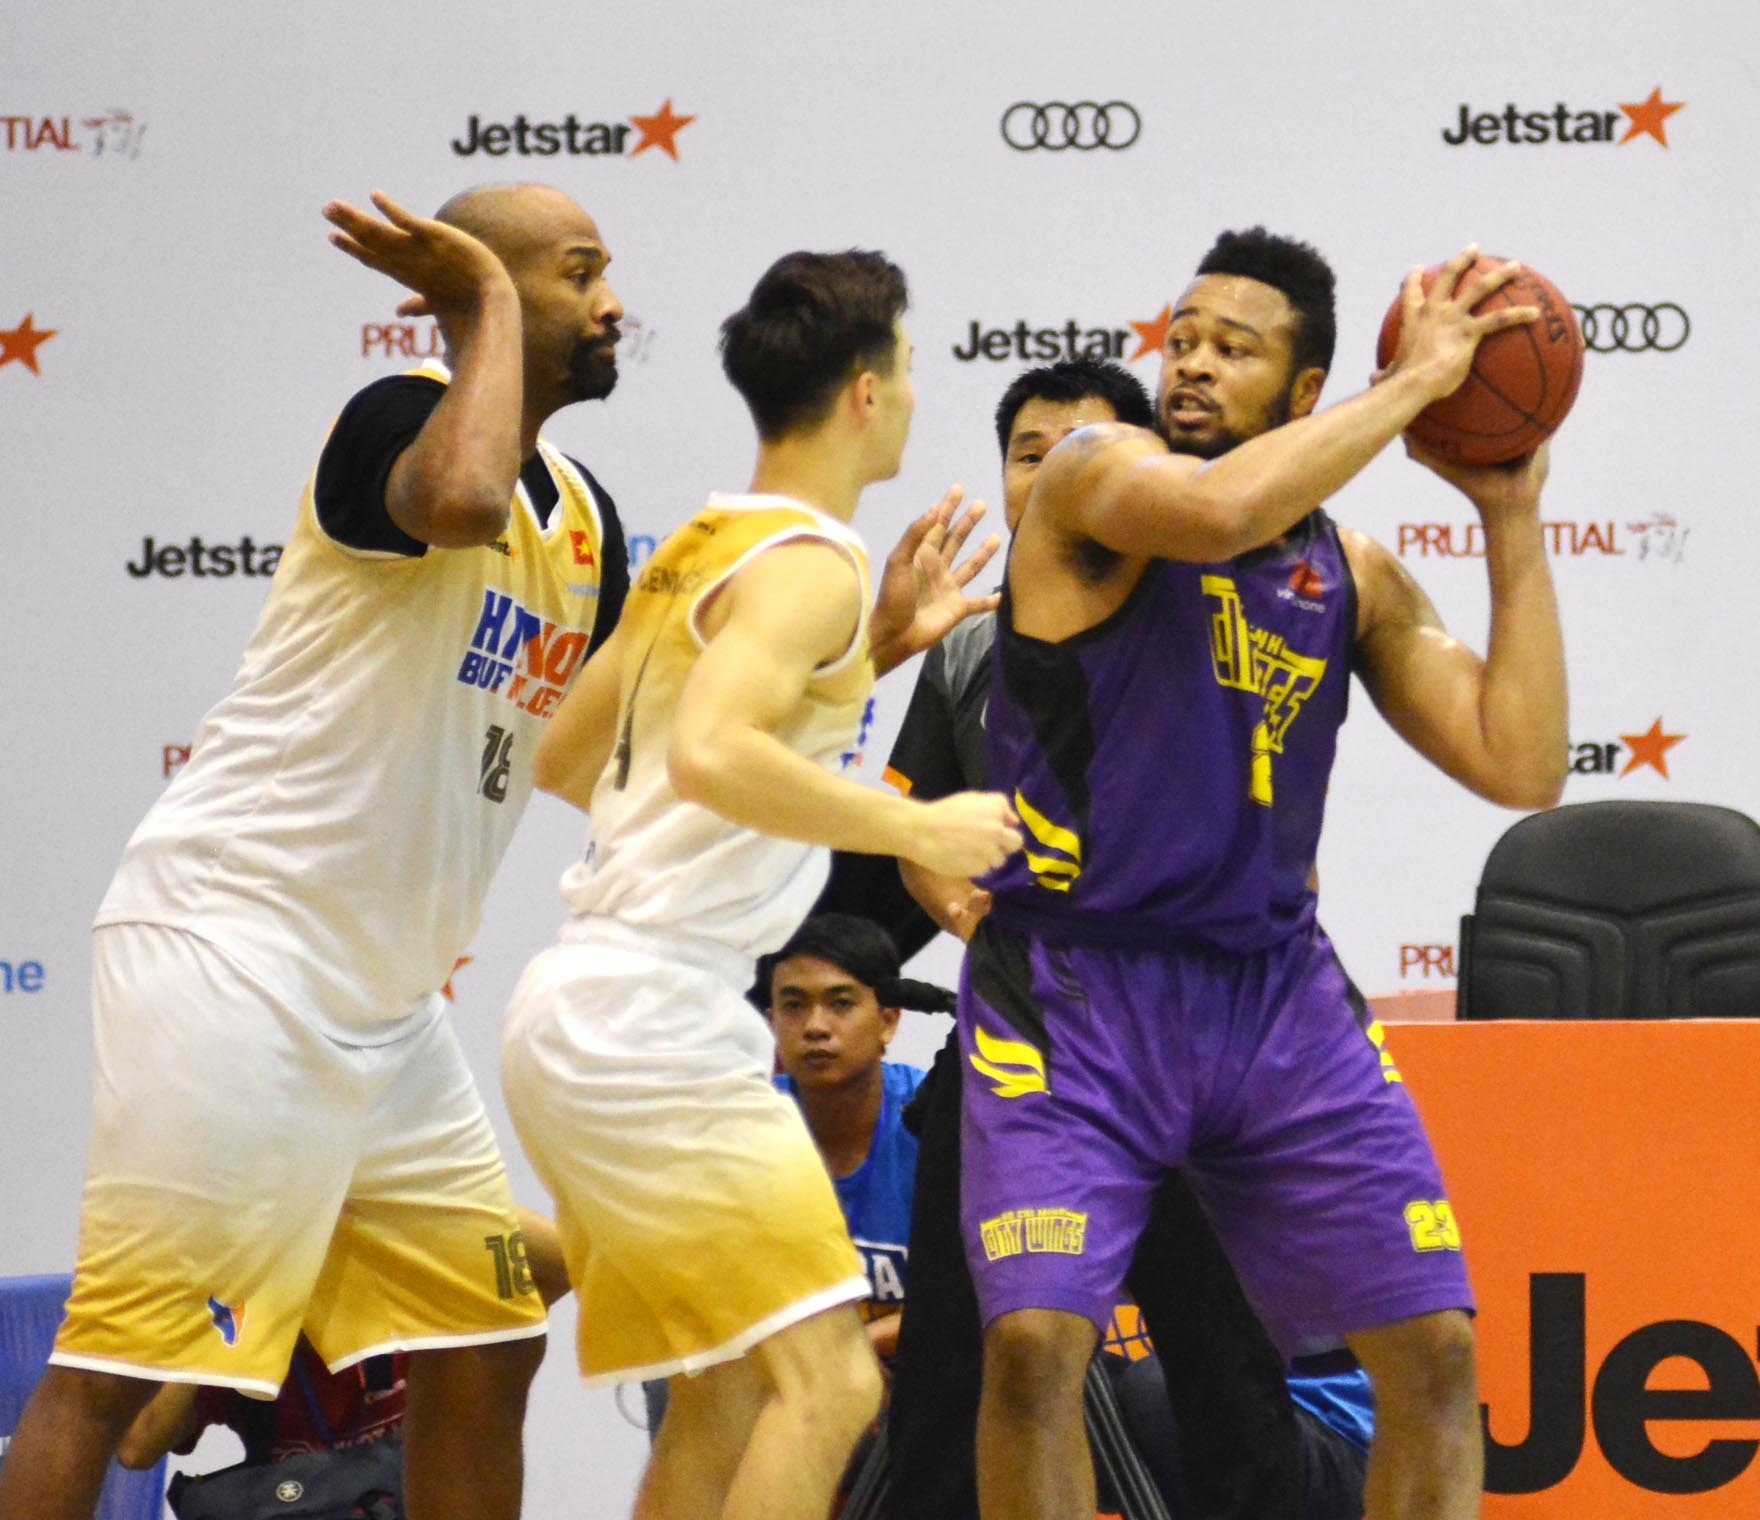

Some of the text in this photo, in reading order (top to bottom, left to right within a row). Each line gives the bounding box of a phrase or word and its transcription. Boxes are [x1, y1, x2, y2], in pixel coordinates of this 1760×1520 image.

[452, 114, 630, 157] Jetstar
[1442, 102, 1620, 146] Jetstar
[363, 323, 440, 358] PRU
[952, 319, 1129, 361] Jetstar
[1398, 520, 1626, 558] PRUDTIAL
[1025, 1213, 1088, 1256] WINGS
[1403, 1199, 1462, 1252] 23
[484, 1229, 537, 1299] 18
[1482, 1272, 1760, 1496] Je
